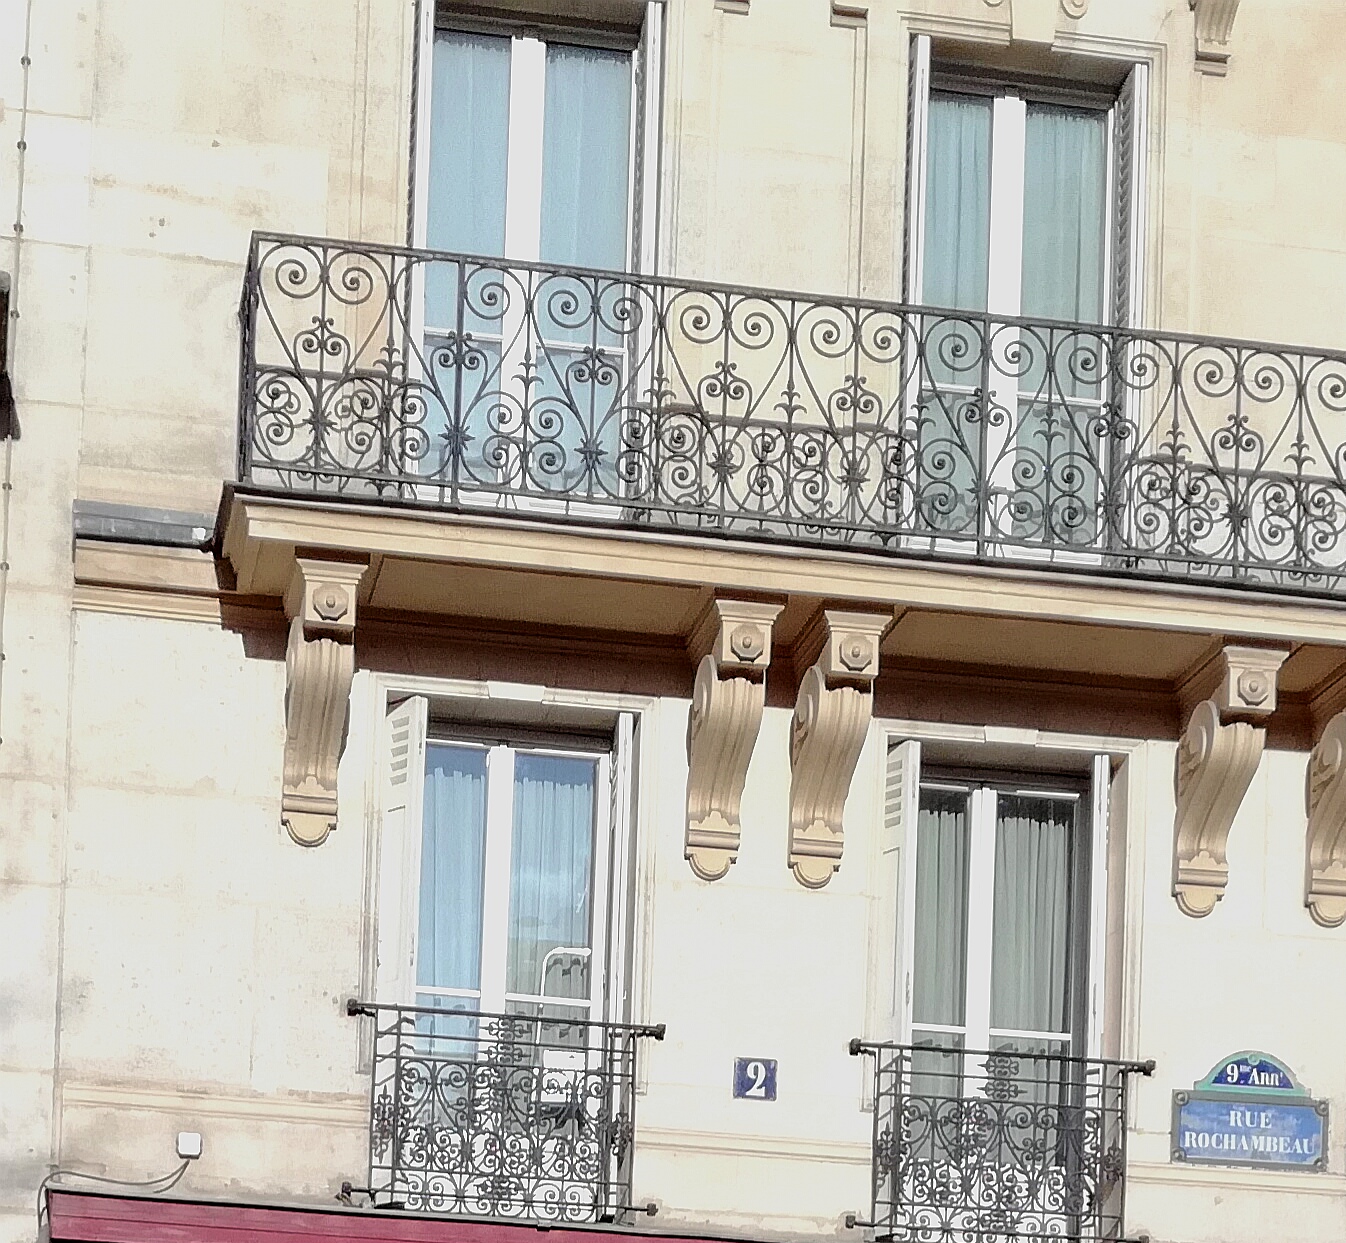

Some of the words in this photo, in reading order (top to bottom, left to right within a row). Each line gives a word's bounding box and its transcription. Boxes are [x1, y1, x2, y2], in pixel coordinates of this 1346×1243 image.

[746, 1061, 766, 1097] 2
[1229, 1109, 1272, 1129] RUE
[1184, 1131, 1315, 1154] ROCHAMBEAU
